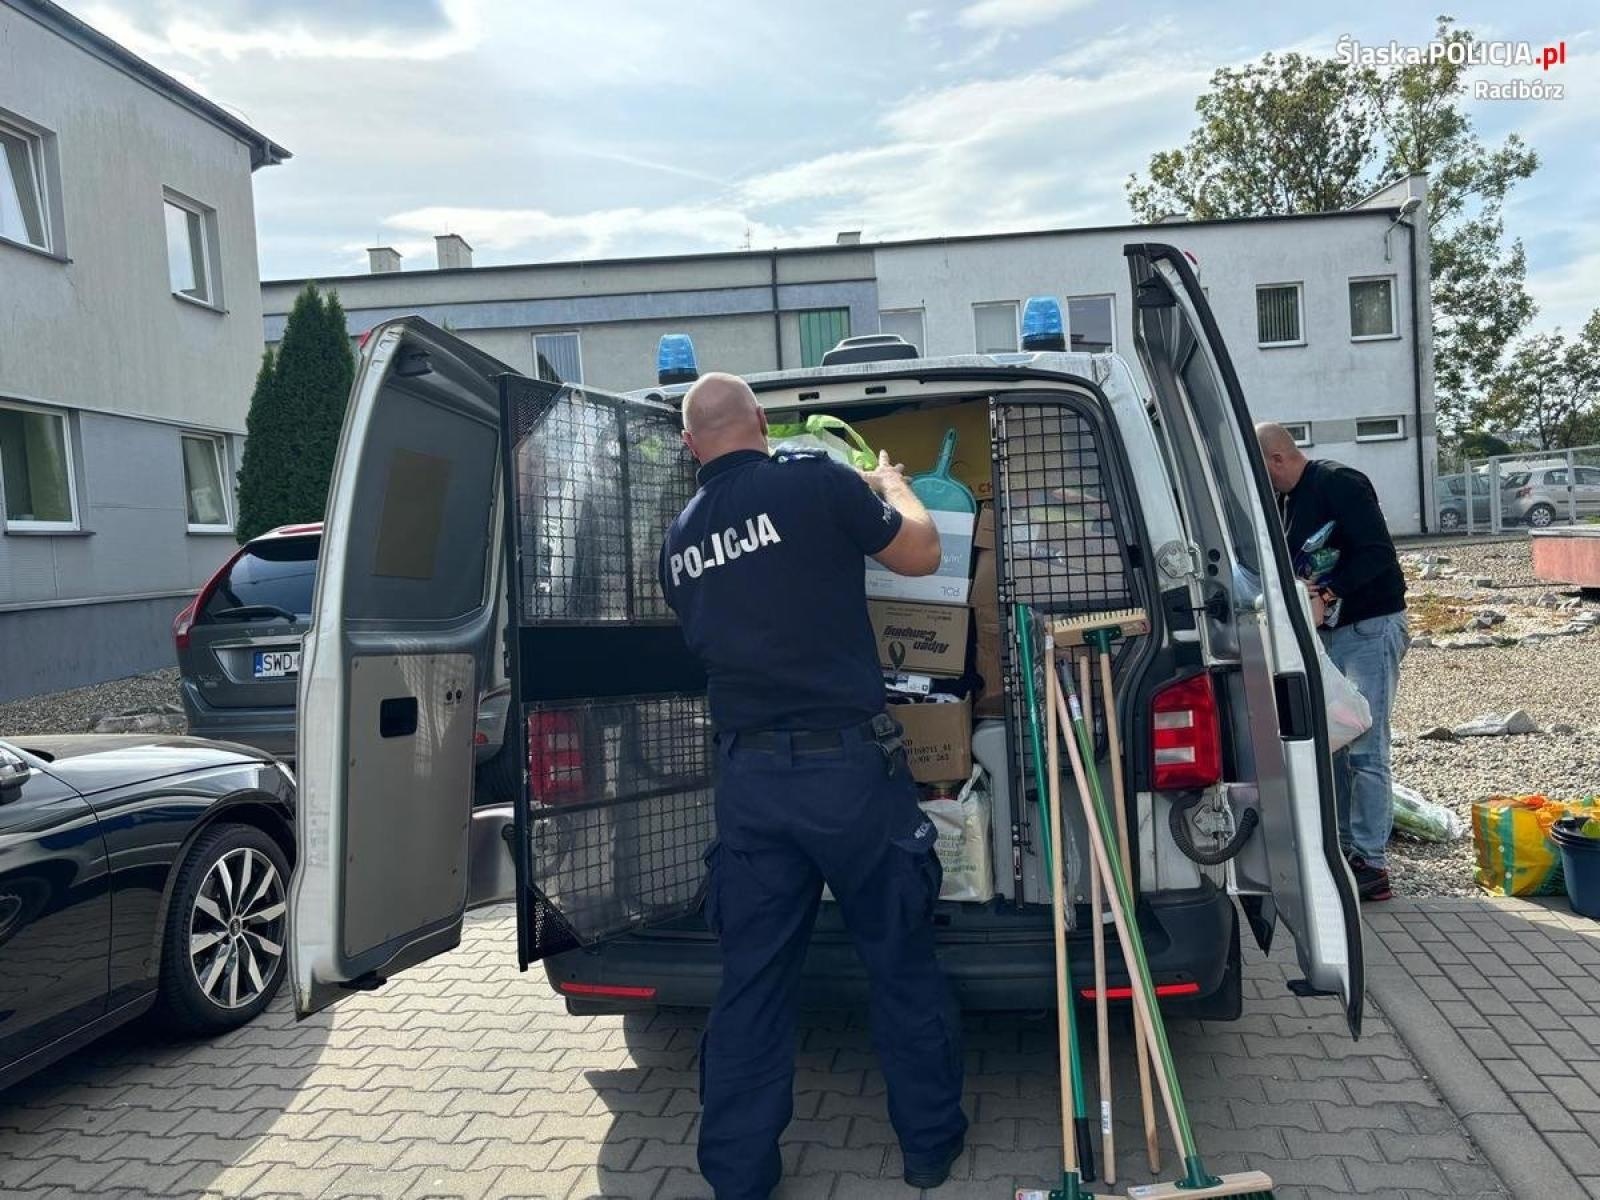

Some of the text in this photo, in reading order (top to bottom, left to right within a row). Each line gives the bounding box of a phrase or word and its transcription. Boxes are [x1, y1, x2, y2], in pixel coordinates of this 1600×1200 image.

[670, 513, 781, 586] POLICJA
[883, 625, 937, 641] Camping
[913, 641, 950, 654] Alpen
[263, 654, 293, 671] SWD
